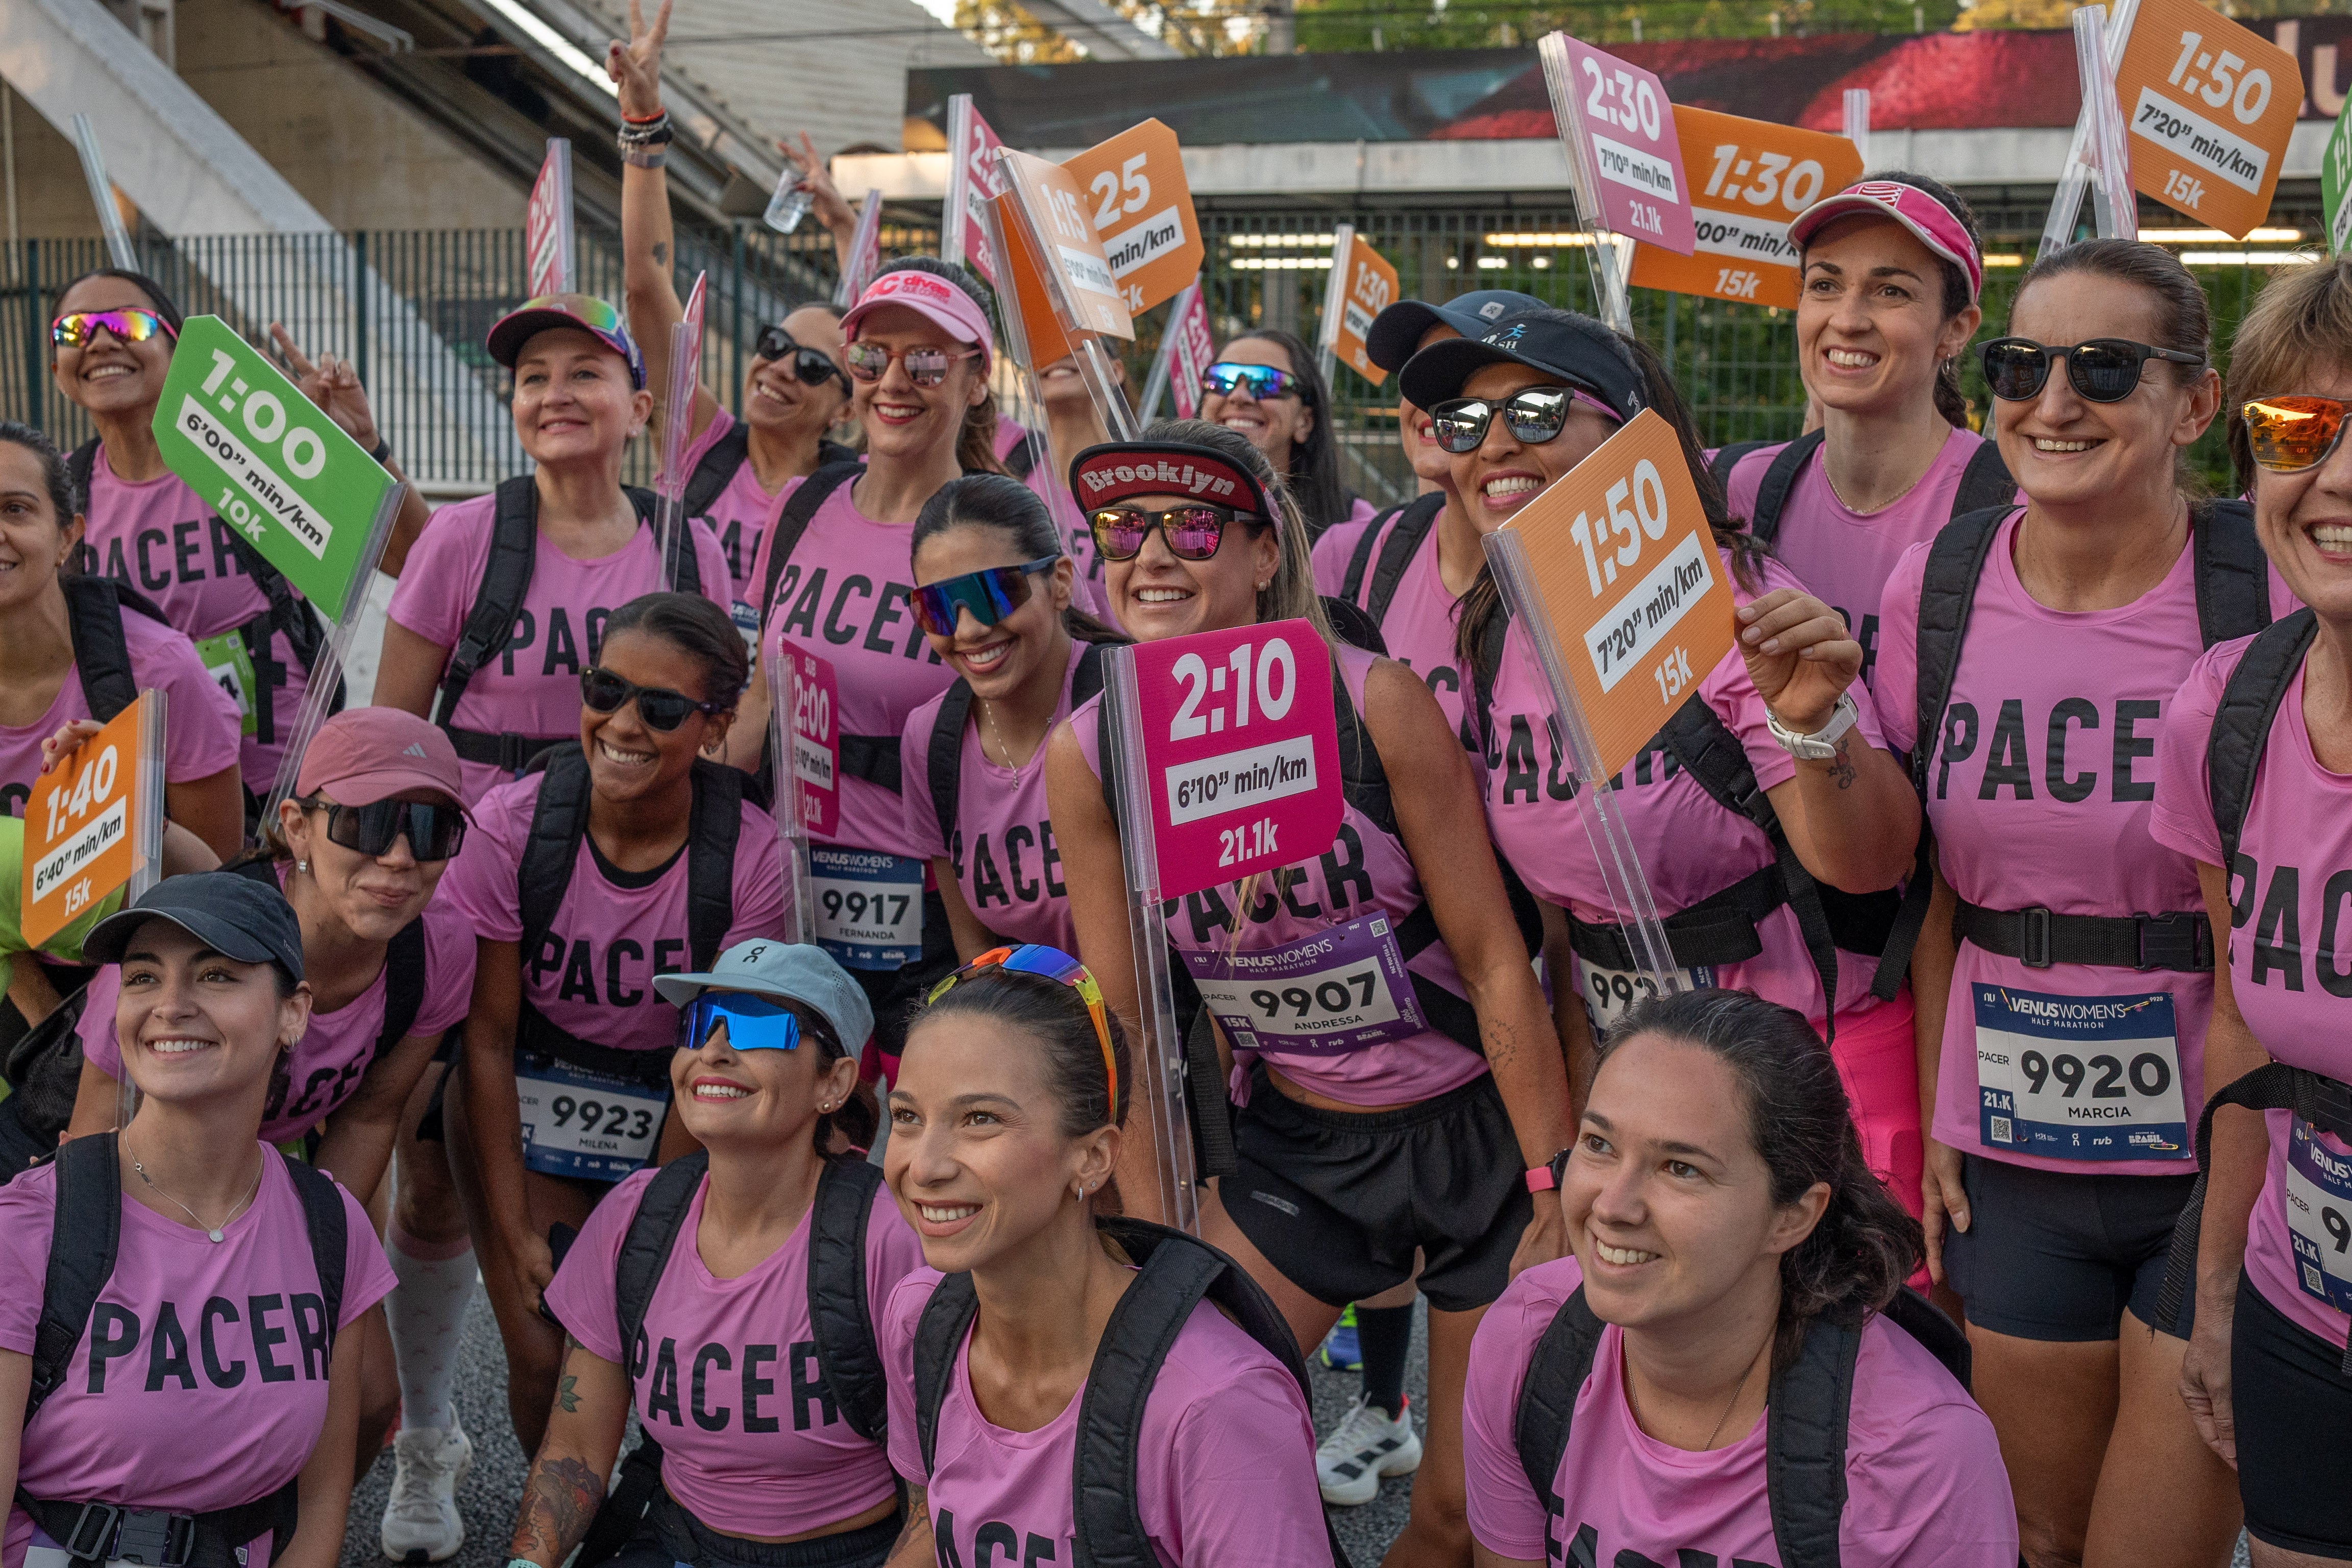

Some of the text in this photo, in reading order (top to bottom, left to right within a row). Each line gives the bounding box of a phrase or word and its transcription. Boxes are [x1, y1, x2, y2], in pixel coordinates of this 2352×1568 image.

[1581, 56, 1660, 141] 2:30
[2168, 31, 2272, 125] 1:50
[2190, 132, 2259, 181] min/km
[2334, 104, 2352, 195] 1:1
[1631, 164, 1673, 192] min/km
[1704, 144, 1825, 213] 1:30
[2162, 168, 2206, 210] 15k
[1040, 183, 1089, 243] 1:15
[1628, 199, 1663, 236] 21.1k
[1109, 225, 1175, 271] min/km
[1353, 261, 1390, 314] 1:30
[1714, 268, 1760, 299] 15k
[201, 348, 327, 480] 1:00
[1082, 460, 1236, 496] Brooklyn
[217, 487, 268, 543] 10k
[246, 468, 324, 546] min/km
[1570, 458, 1669, 599] 1:50
[1646, 556, 1703, 629] min/km
[1169, 637, 1296, 742] 2:10
[1654, 645, 1694, 705] 15k
[794, 673, 830, 743] 2:00
[45, 744, 118, 844] 1:40
[1177, 755, 1308, 808] 6'10" min/km
[74, 815, 121, 864] min/km
[1218, 817, 1280, 868] 21.1k
[64, 880, 92, 917] 15k
[822, 888, 911, 926] 9917
[839, 927, 896, 940] FERNANDA
[1271, 958, 1317, 972] MARATHON
[1203, 993, 1237, 1001] PACER
[1250, 970, 1376, 1018] 9907
[1222, 1017, 1251, 1028] 15K
[1294, 1014, 1364, 1030] ANDRESSA
[2031, 1017, 2104, 1029] HALF MARATHON
[1978, 1050, 2010, 1066] PACER
[2021, 1049, 2171, 1098] 9920
[551, 1094, 653, 1141] 9923
[1983, 1090, 2012, 1111] 21.1K
[2068, 1106, 2132, 1119] MARCIA
[579, 1137, 618, 1150] MILENA
[2093, 1136, 2113, 1145] rvb
[2128, 1134, 2163, 1144] BRASIL
[2286, 1187, 2311, 1215] PACER
[2323, 1172, 2341, 1186] HALF
[86, 1292, 330, 1394] PACER
